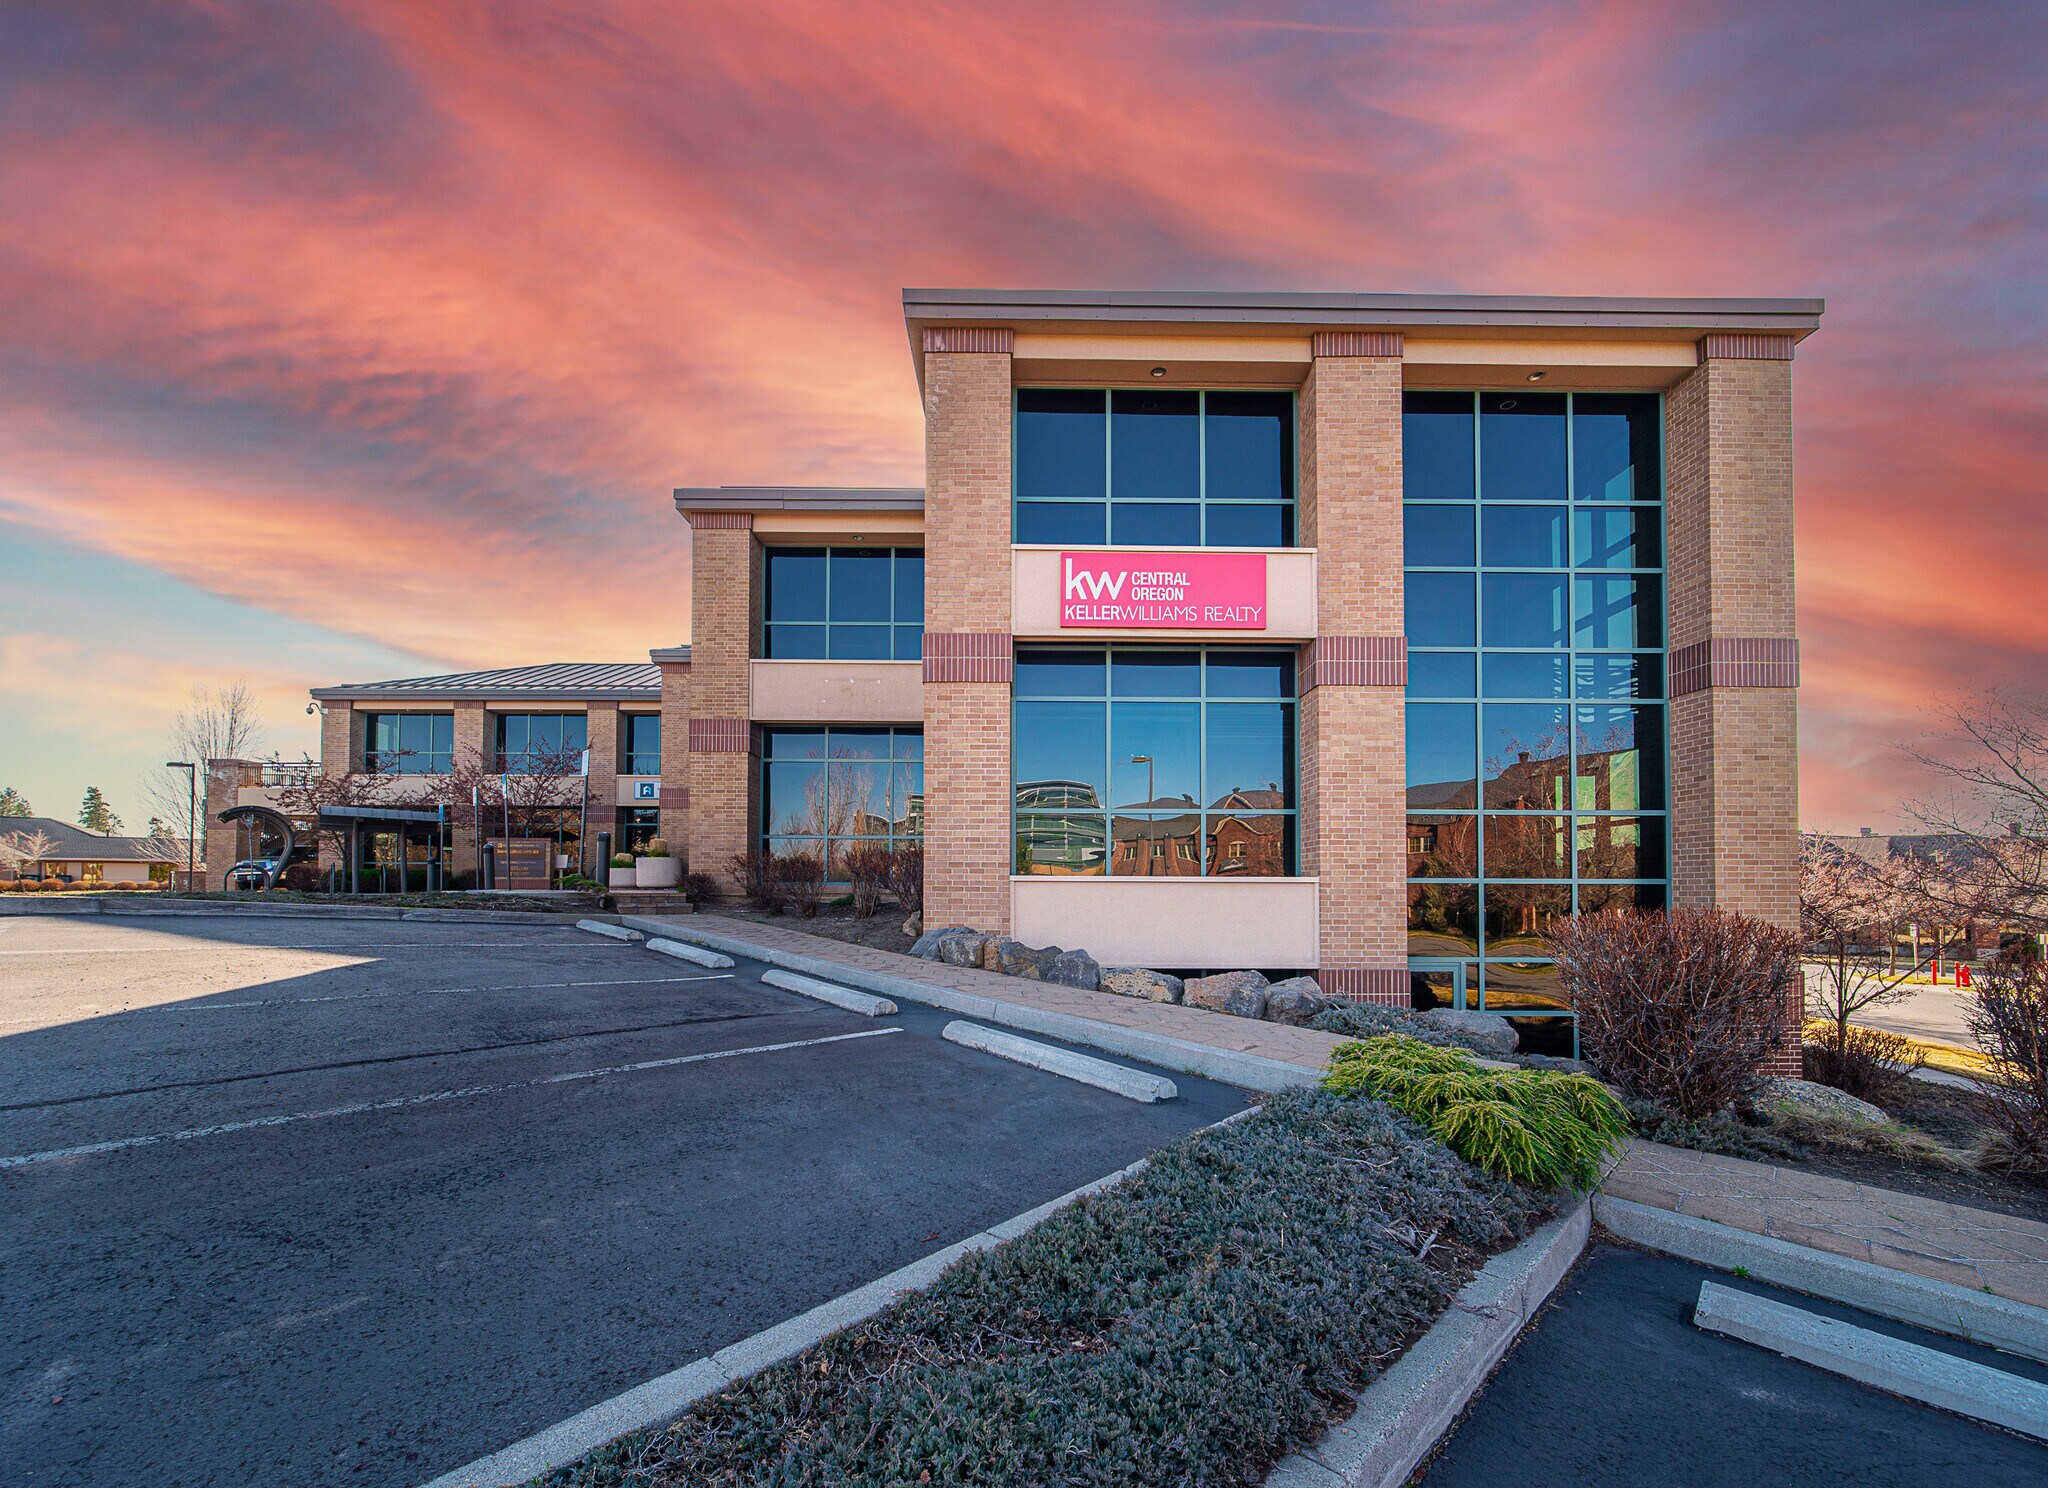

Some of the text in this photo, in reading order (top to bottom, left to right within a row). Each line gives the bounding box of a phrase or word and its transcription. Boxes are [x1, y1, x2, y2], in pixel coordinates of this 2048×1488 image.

[1065, 558, 1128, 600] kw
[1131, 572, 1190, 586] CENTRAL
[1131, 587, 1184, 601] OREGON
[1204, 607, 1263, 622] REALTY
